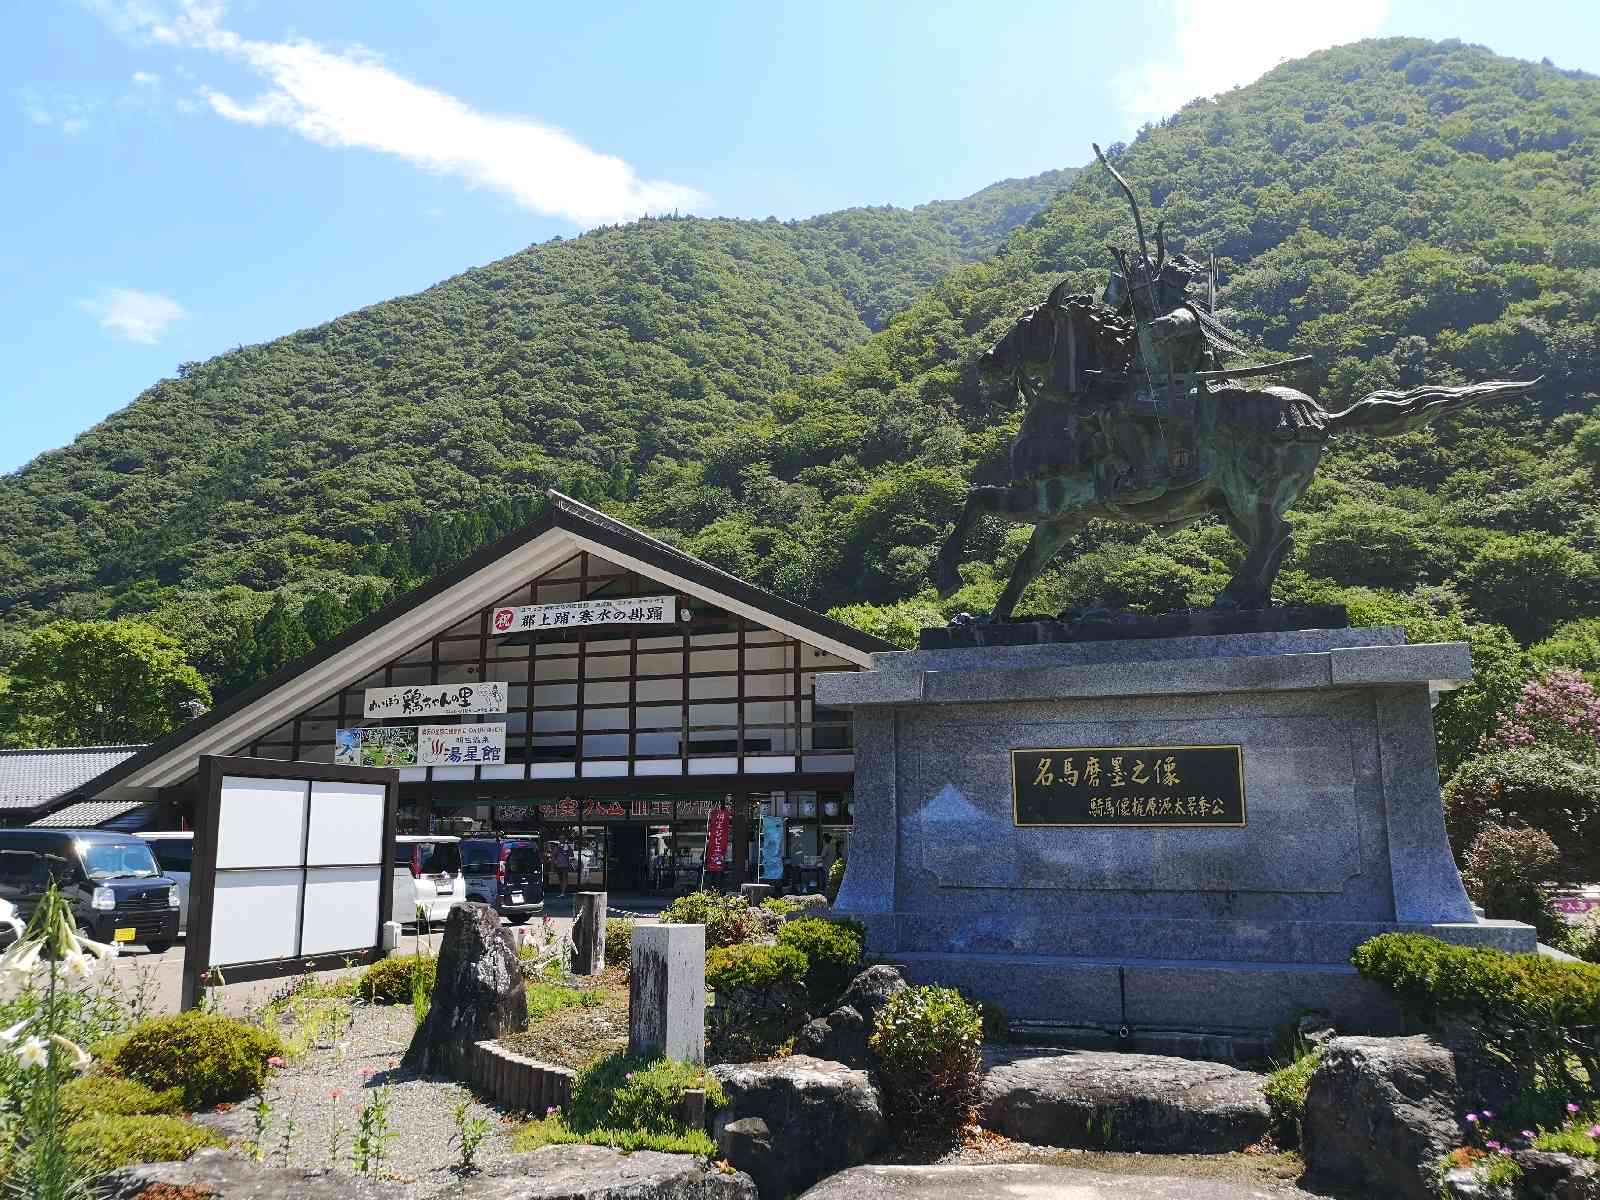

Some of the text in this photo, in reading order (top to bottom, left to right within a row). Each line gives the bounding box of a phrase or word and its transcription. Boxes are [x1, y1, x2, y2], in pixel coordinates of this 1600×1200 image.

[496, 612, 513, 630] 祝
[444, 745, 501, 763] 湯星館
[1032, 756, 1182, 787] 名馬磨墨之像
